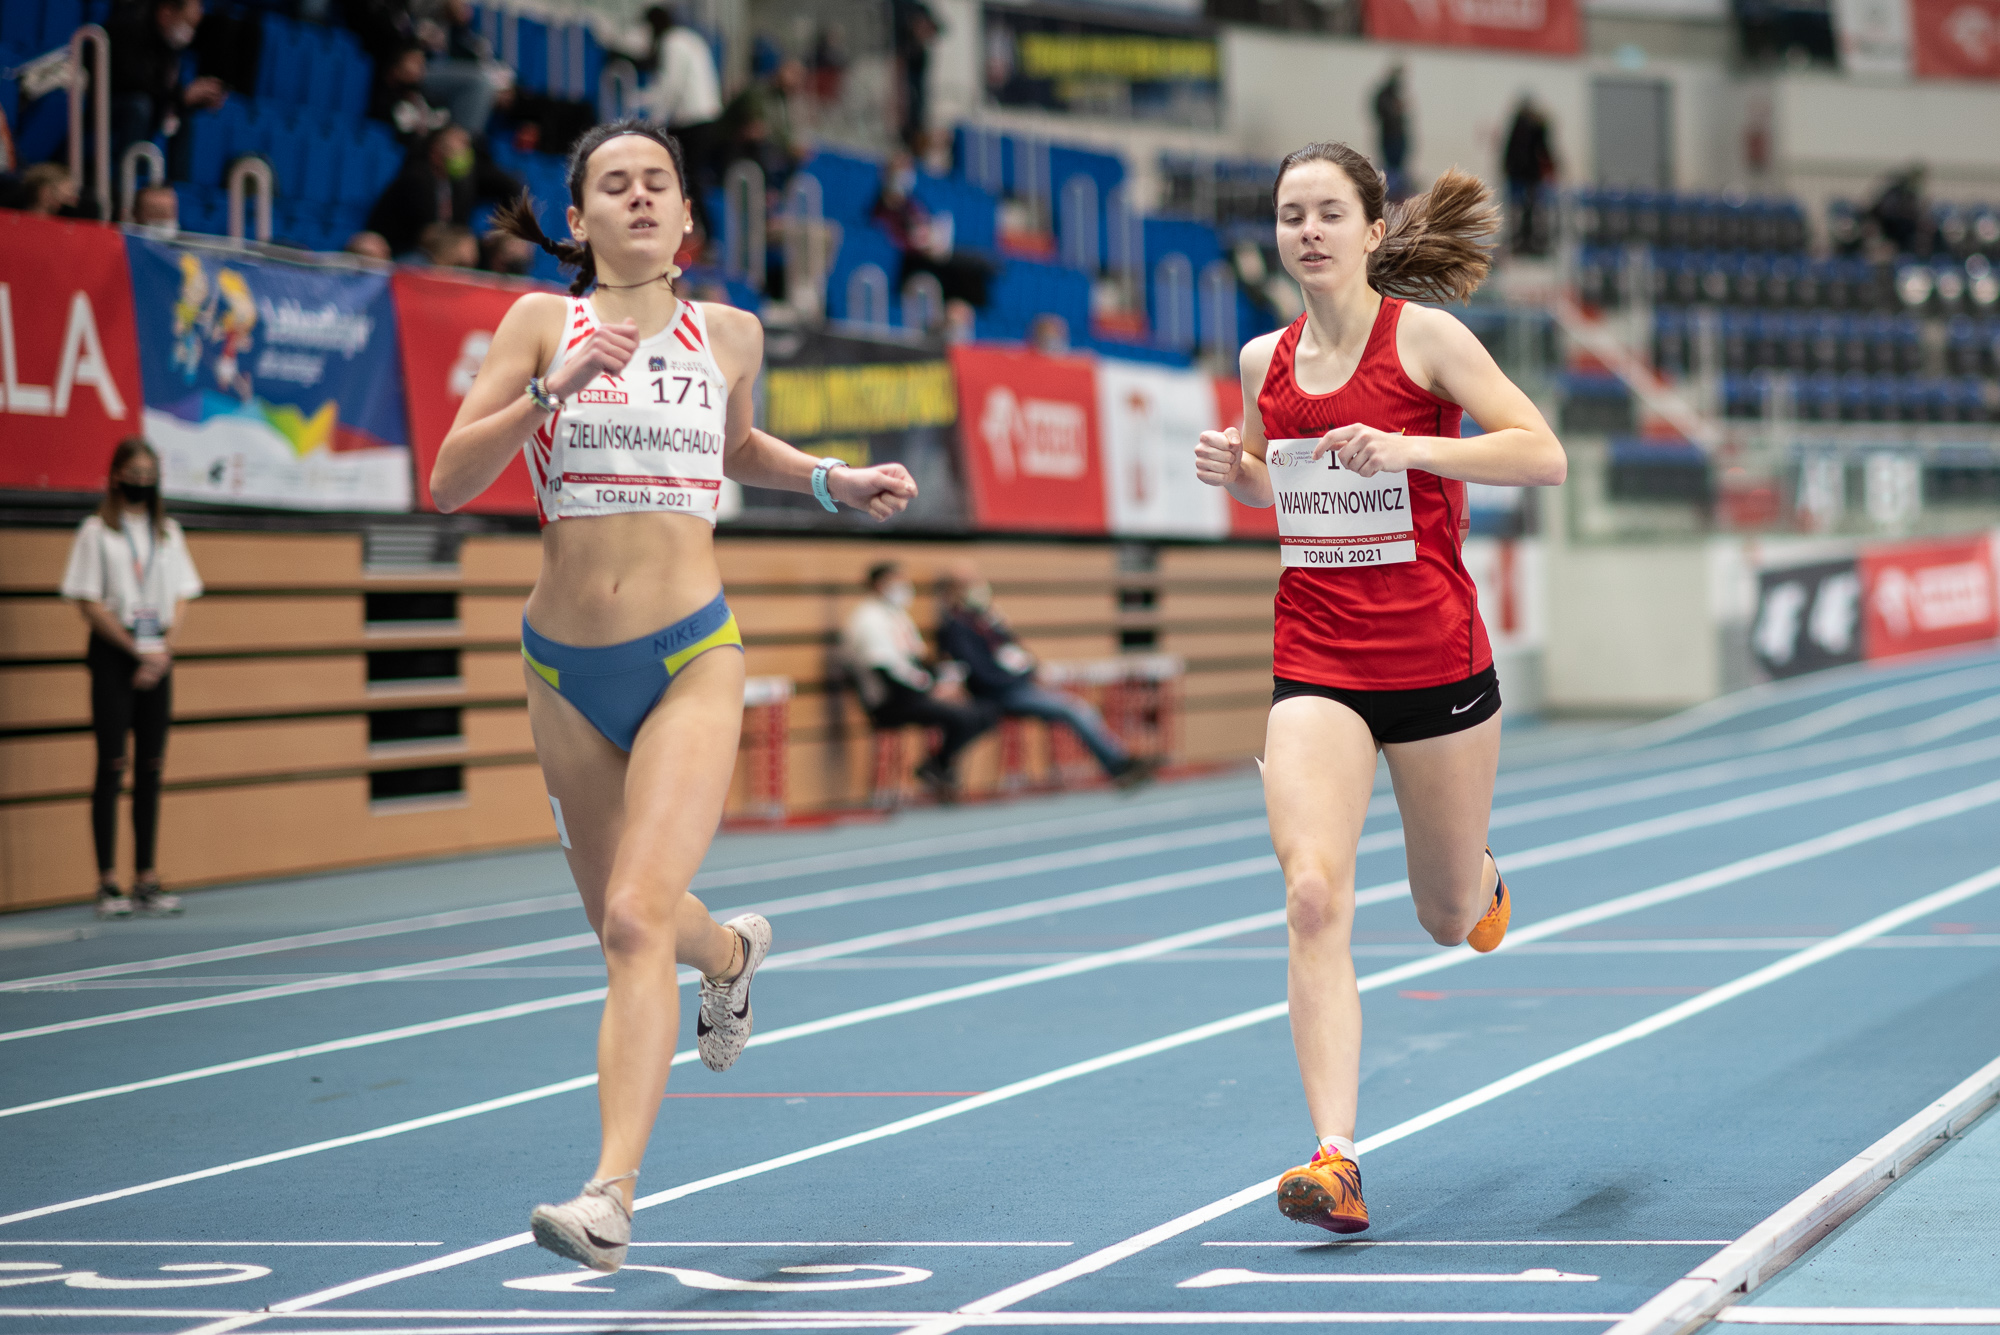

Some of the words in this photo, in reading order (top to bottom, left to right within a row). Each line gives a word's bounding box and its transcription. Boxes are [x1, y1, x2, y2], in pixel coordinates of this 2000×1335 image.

[0, 283, 126, 421] LA
[581, 390, 626, 404] ORLEN
[651, 376, 712, 410] 171
[569, 418, 720, 455] ZIELIŃSKA-MACHADO
[596, 487, 651, 504] TORUŃ
[656, 491, 691, 507] 2021
[1279, 487, 1404, 514] WAWRZYNOWICZ
[1304, 547, 1344, 563] TORUŃ
[1348, 549, 1381, 563] 2021
[654, 619, 701, 655] NIKE
